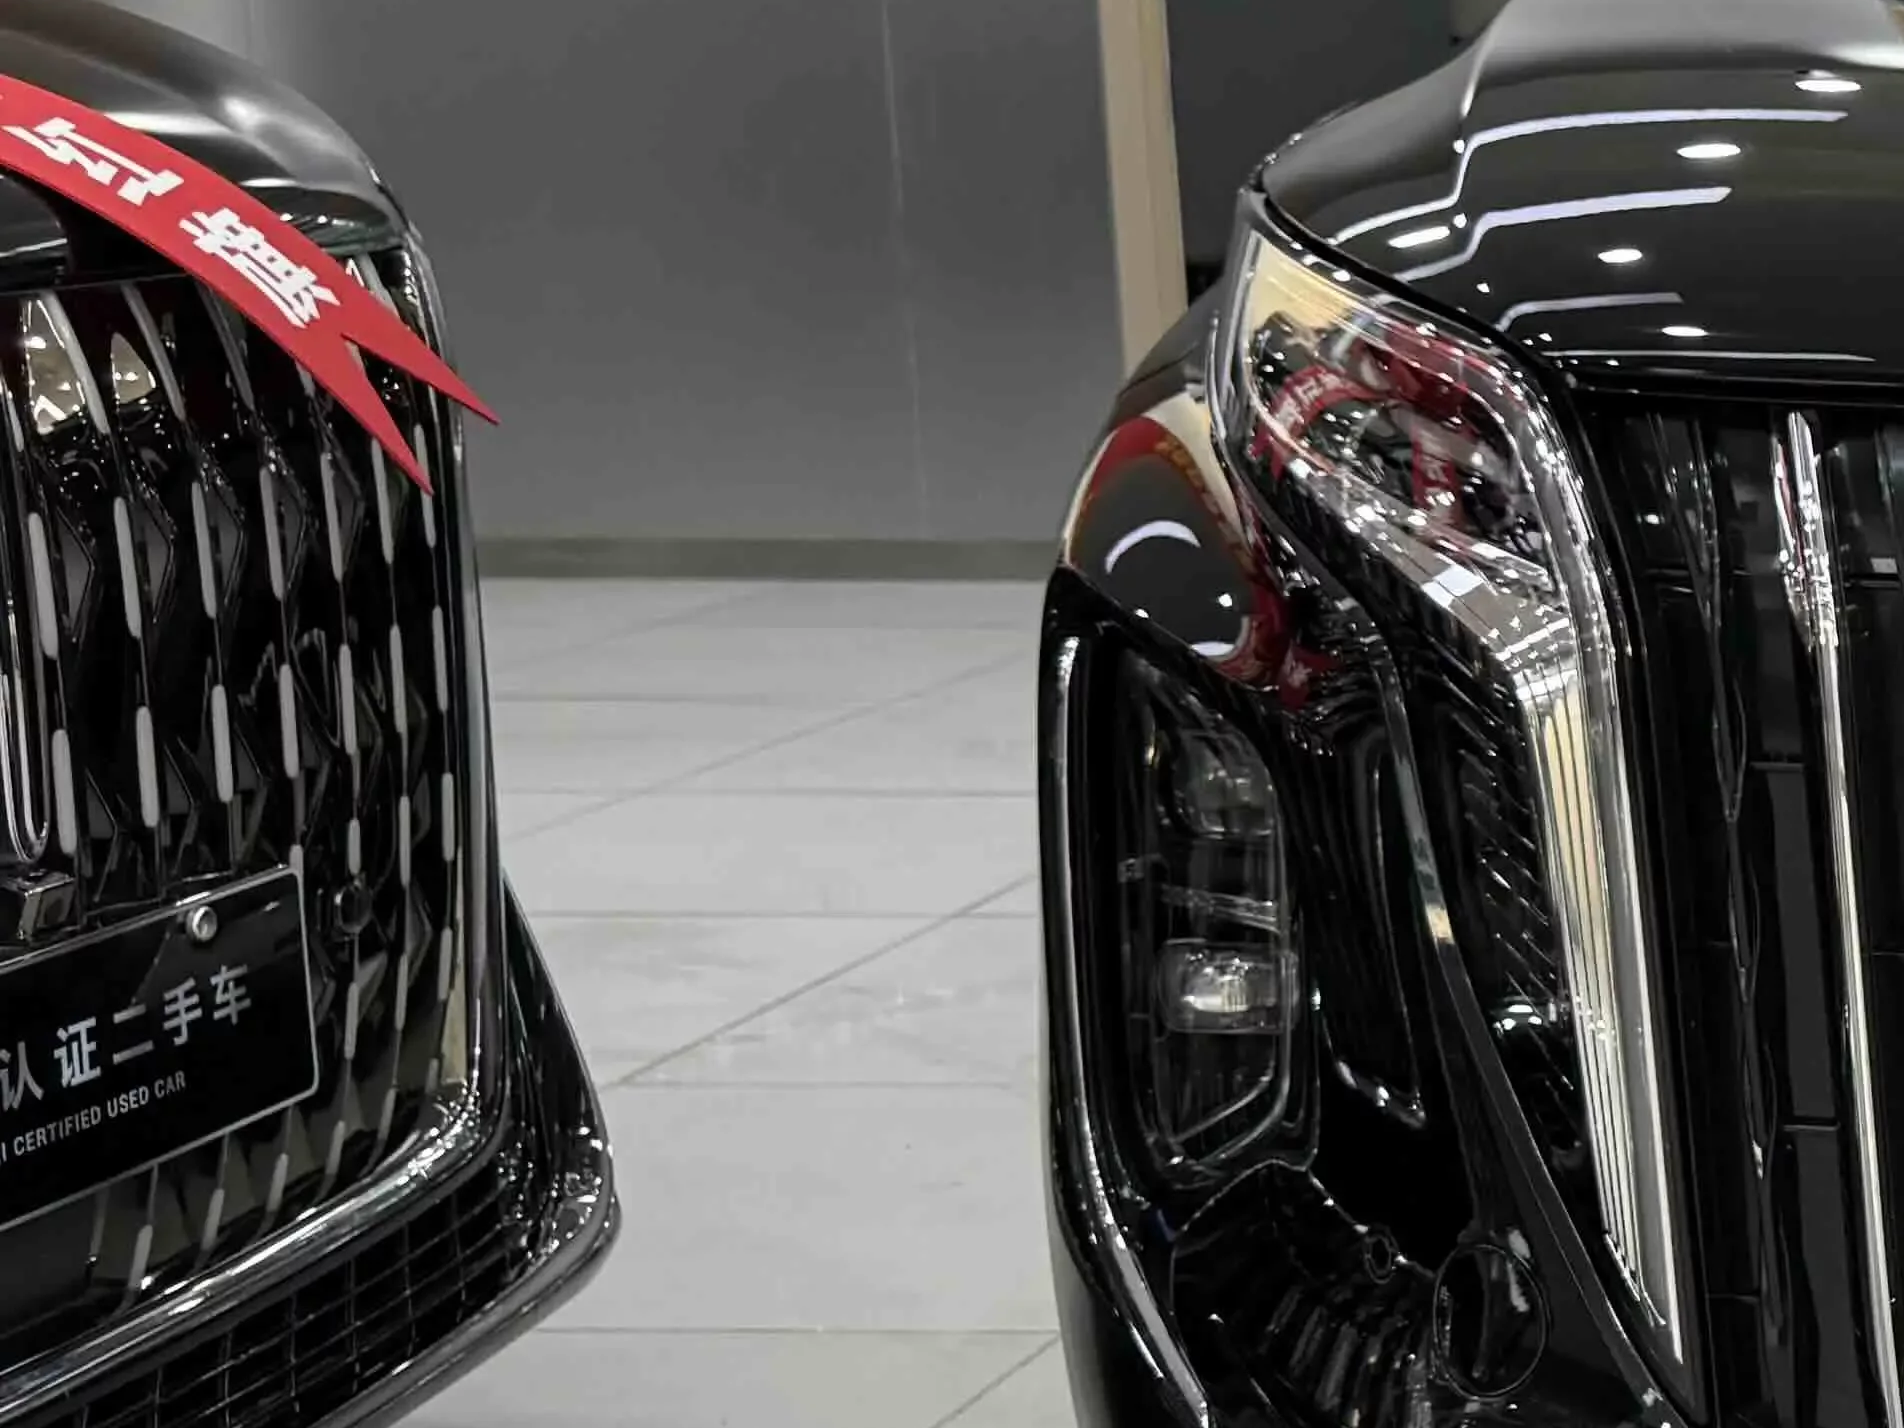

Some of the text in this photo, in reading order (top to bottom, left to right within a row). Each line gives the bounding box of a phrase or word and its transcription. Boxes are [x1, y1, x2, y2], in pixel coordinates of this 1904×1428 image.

[13, 1105, 101, 1156] CERTIFIED
[107, 1085, 150, 1119] USED
[153, 1070, 187, 1099] CAR
